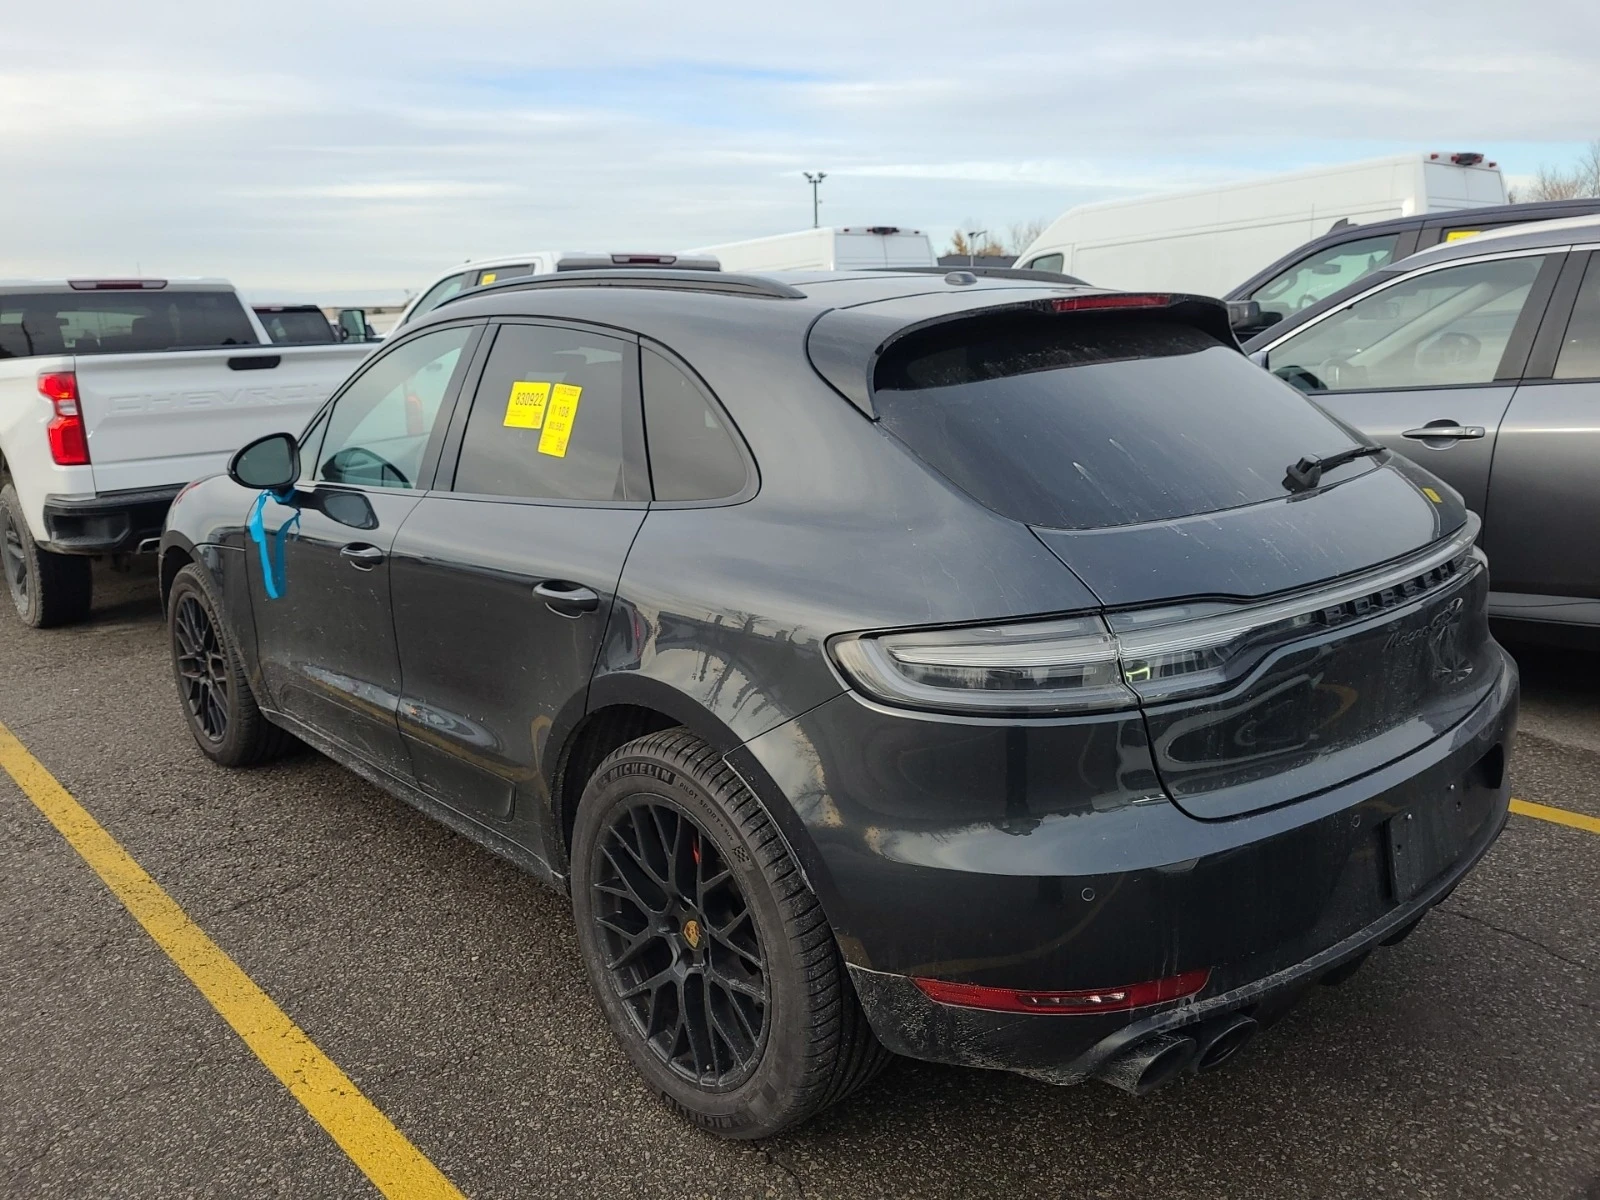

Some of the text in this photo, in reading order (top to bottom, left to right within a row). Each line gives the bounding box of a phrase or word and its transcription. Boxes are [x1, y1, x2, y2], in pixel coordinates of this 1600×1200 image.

[515, 392, 544, 407] 830922
[1323, 557, 1464, 625] PORSCHE
[1381, 625, 1428, 652] Macan
[609, 762, 672, 782] MICHELIN
[679, 783, 699, 800] PILOT
[700, 799, 721, 824] SPORT
